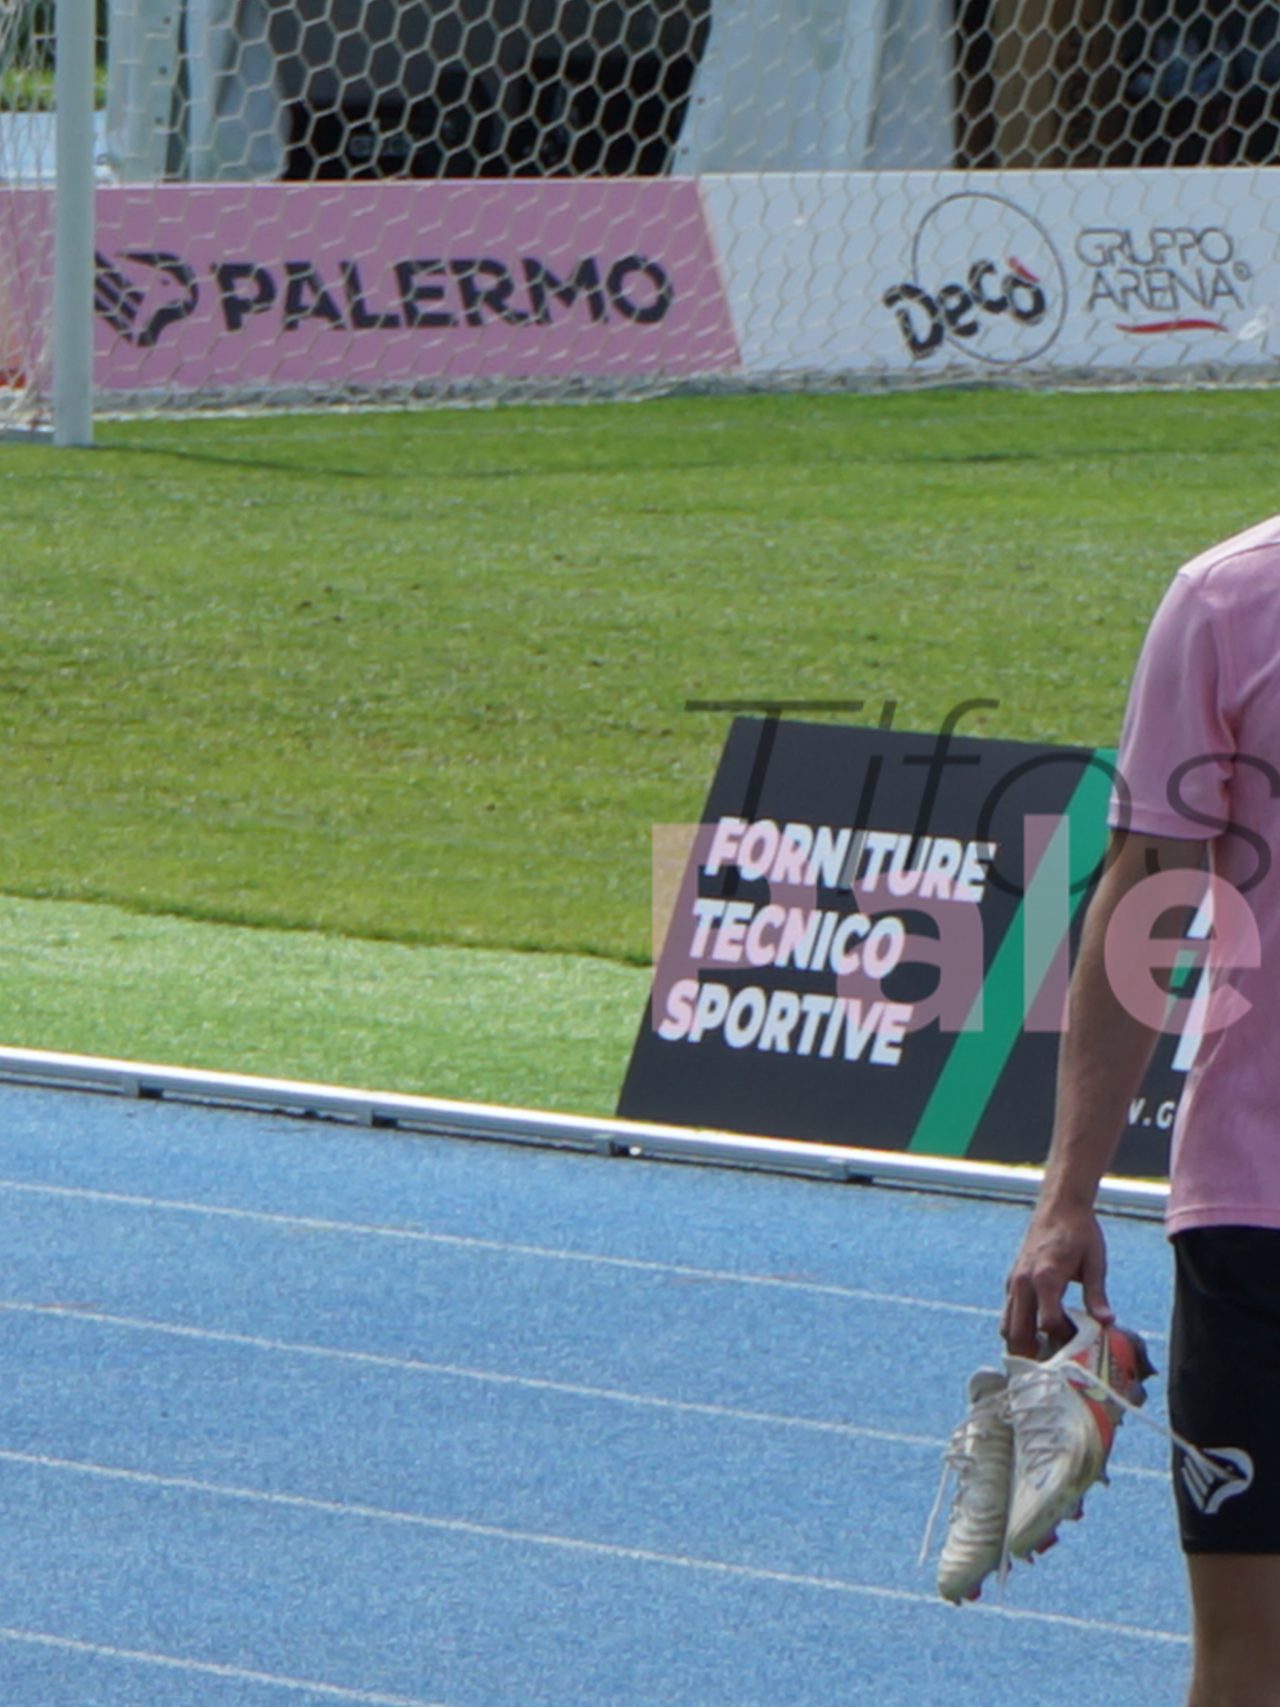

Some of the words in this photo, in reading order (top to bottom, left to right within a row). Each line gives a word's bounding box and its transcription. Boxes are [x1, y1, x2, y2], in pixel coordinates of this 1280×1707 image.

[1074, 226, 1234, 267] GRUPPO
[210, 254, 674, 331] PALERMO
[704, 816, 998, 903] FORNITURE
[689, 897, 906, 981] TECNICO
[657, 978, 914, 1066] SPORTIVE
